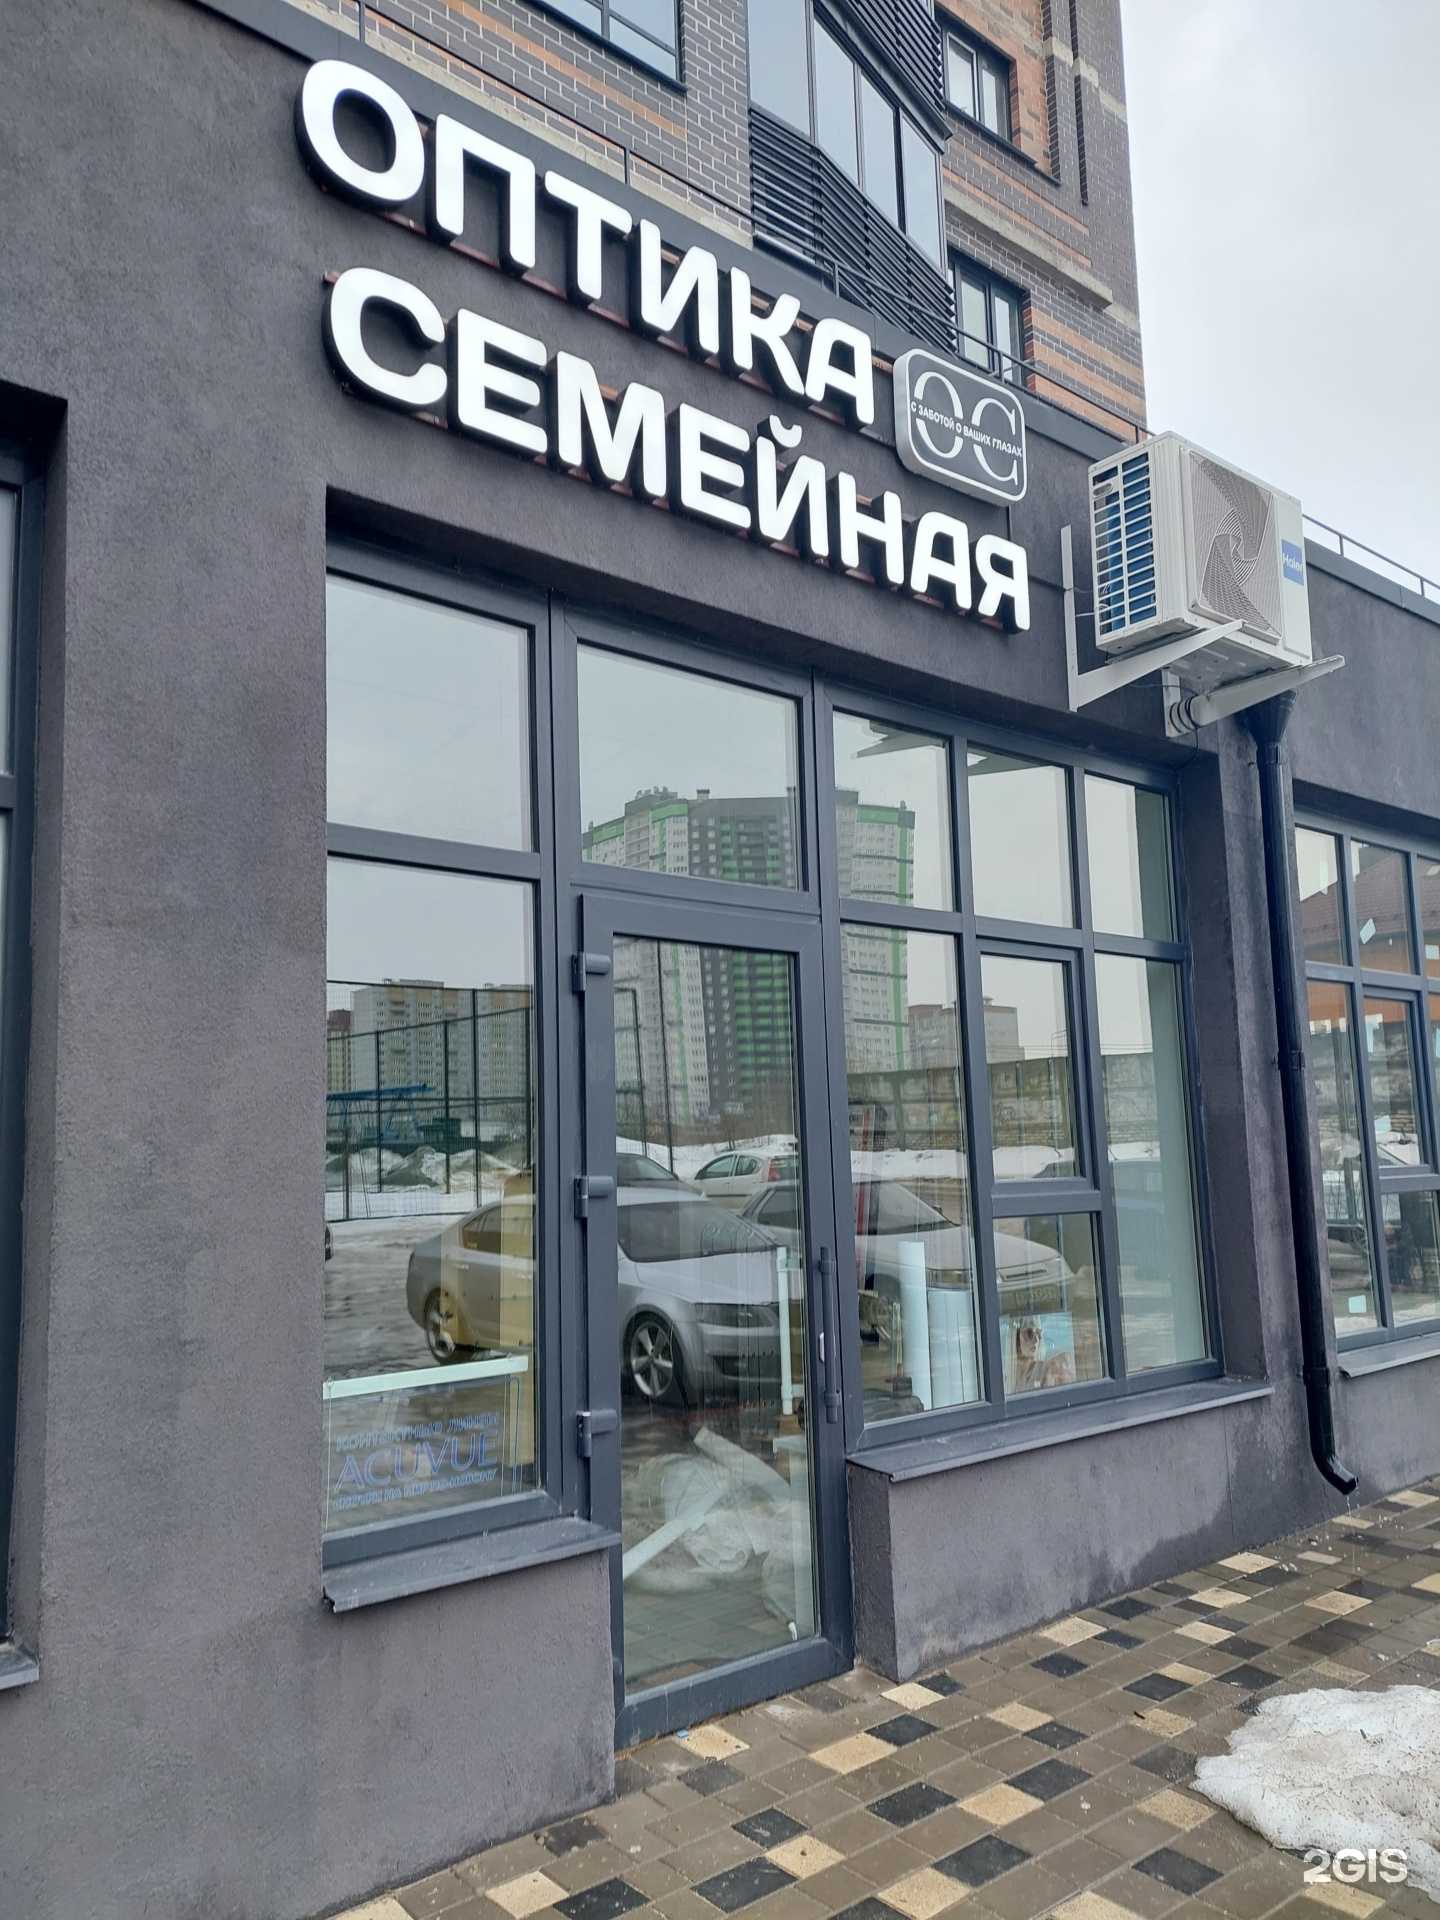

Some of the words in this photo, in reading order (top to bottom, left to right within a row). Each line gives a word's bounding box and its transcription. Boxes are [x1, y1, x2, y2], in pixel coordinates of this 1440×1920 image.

[302, 60, 875, 425] ОПТИКА
[329, 267, 1030, 631] СЕМЕЙНАЯ
[911, 401, 917, 412] С
[918, 404, 955, 430] ЗАБОТОЙ
[955, 422, 962, 433] О
[963, 425, 991, 447] ВАШИХ
[992, 438, 1022, 458] ГЛАЗАХ
[335, 1432, 498, 1490] ACUVUE
